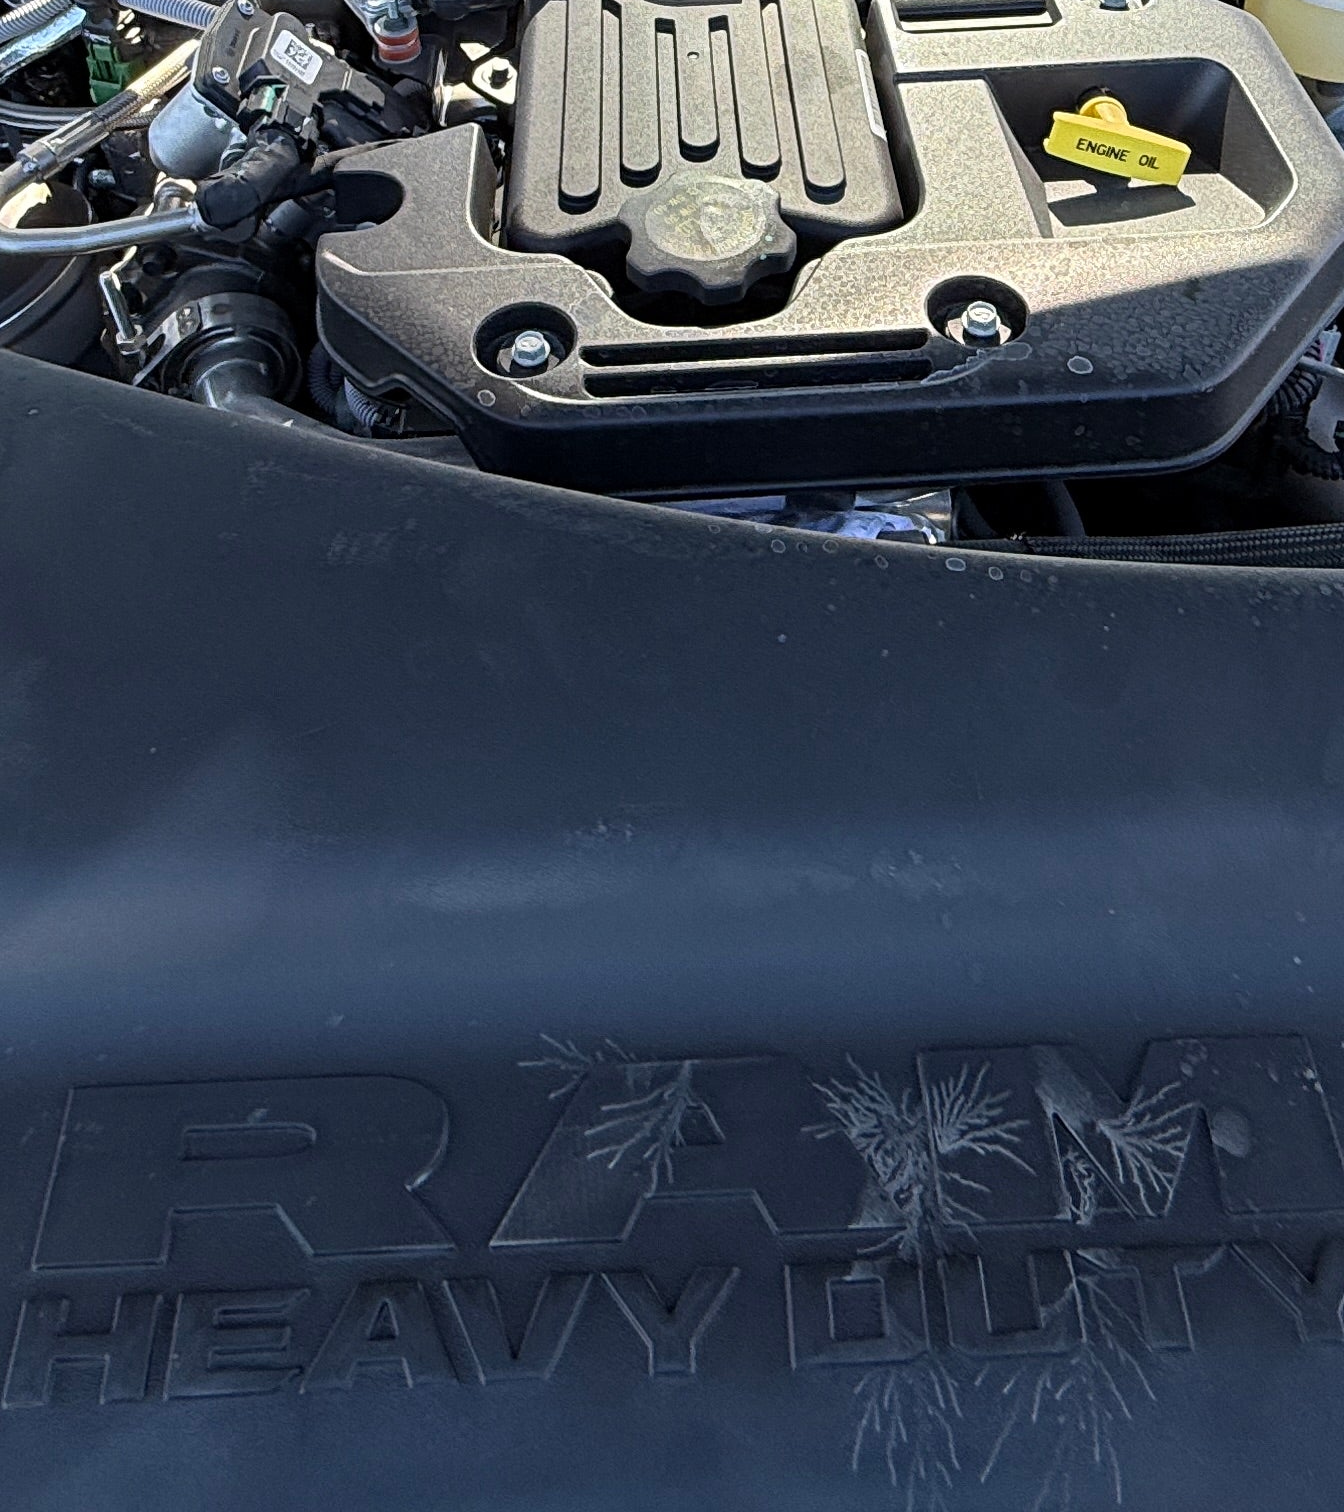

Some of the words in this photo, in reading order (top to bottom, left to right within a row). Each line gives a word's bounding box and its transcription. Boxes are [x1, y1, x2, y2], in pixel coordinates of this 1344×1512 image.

[1076, 138, 1130, 162] ENGINE
[1138, 154, 1160, 170] OIL
[2, 1265, 742, 1410] HEAVY
